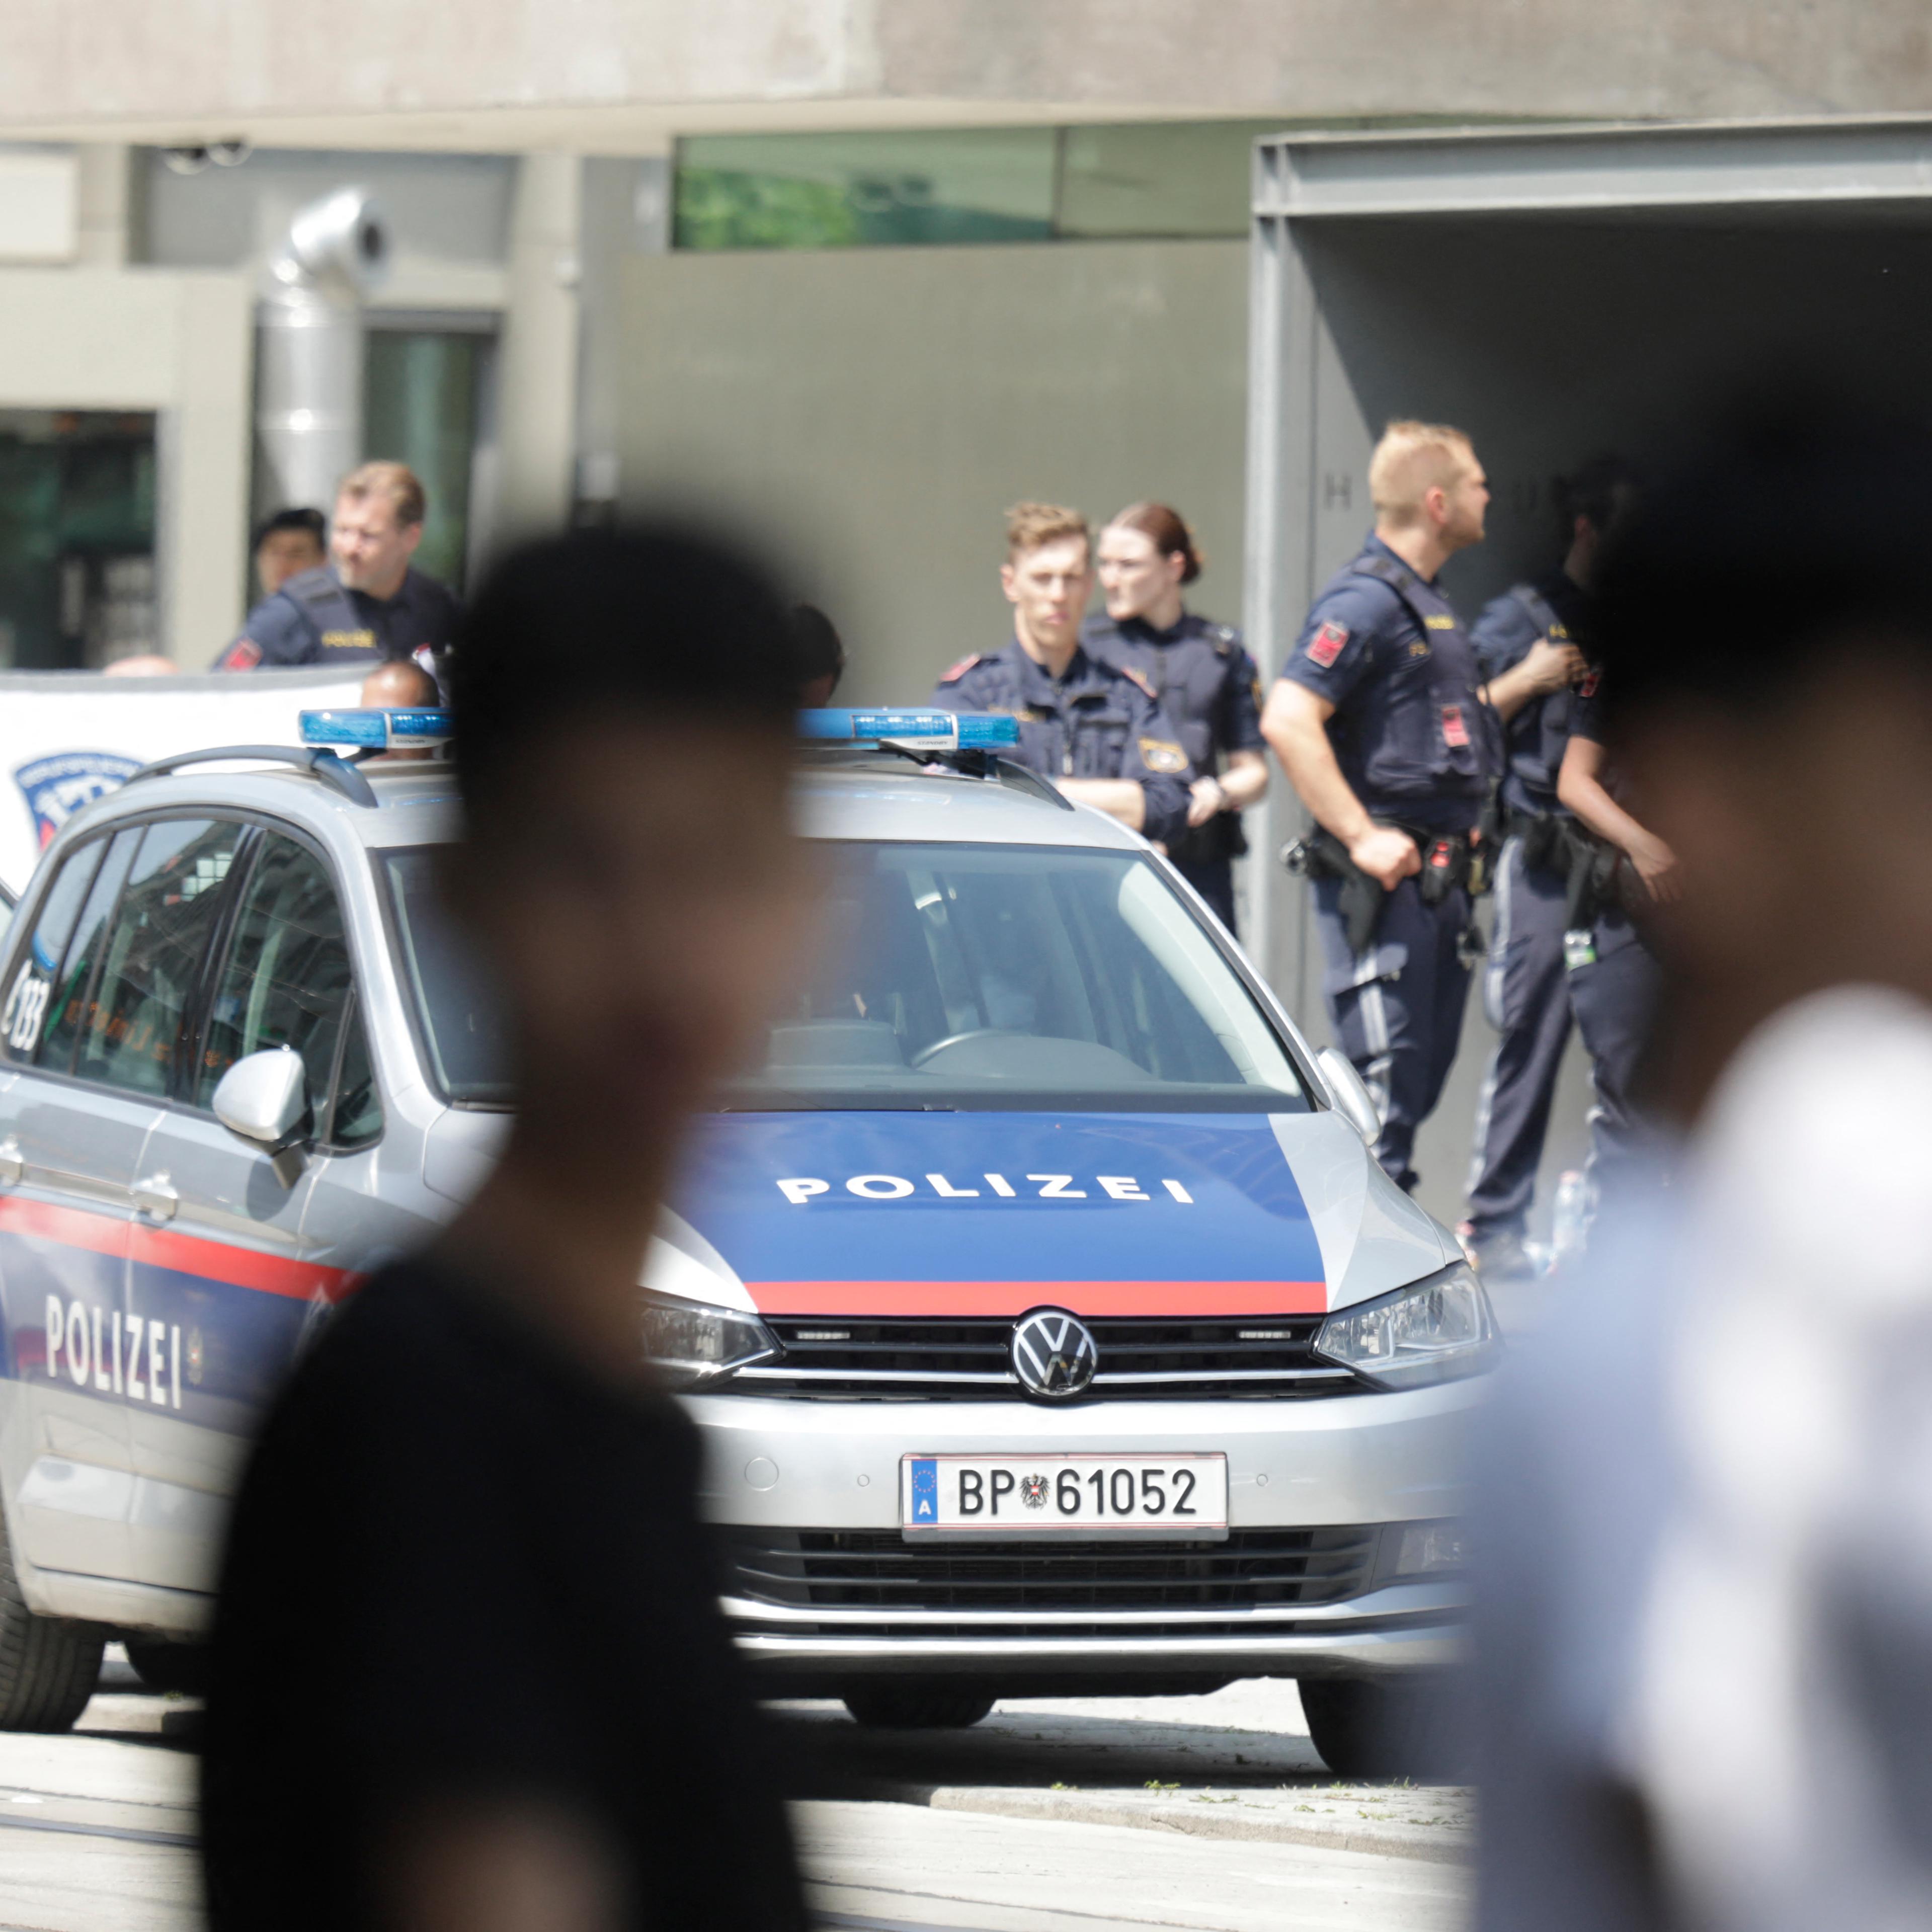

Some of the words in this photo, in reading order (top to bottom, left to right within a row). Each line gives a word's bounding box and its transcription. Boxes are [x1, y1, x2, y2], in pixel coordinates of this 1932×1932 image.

[777, 1174, 1194, 1203] POLIZEI
[46, 1294, 181, 1409] POLIZEI
[918, 1500, 932, 1515] A
[959, 1469, 1015, 1515] BP
[1057, 1468, 1196, 1515] 61052
